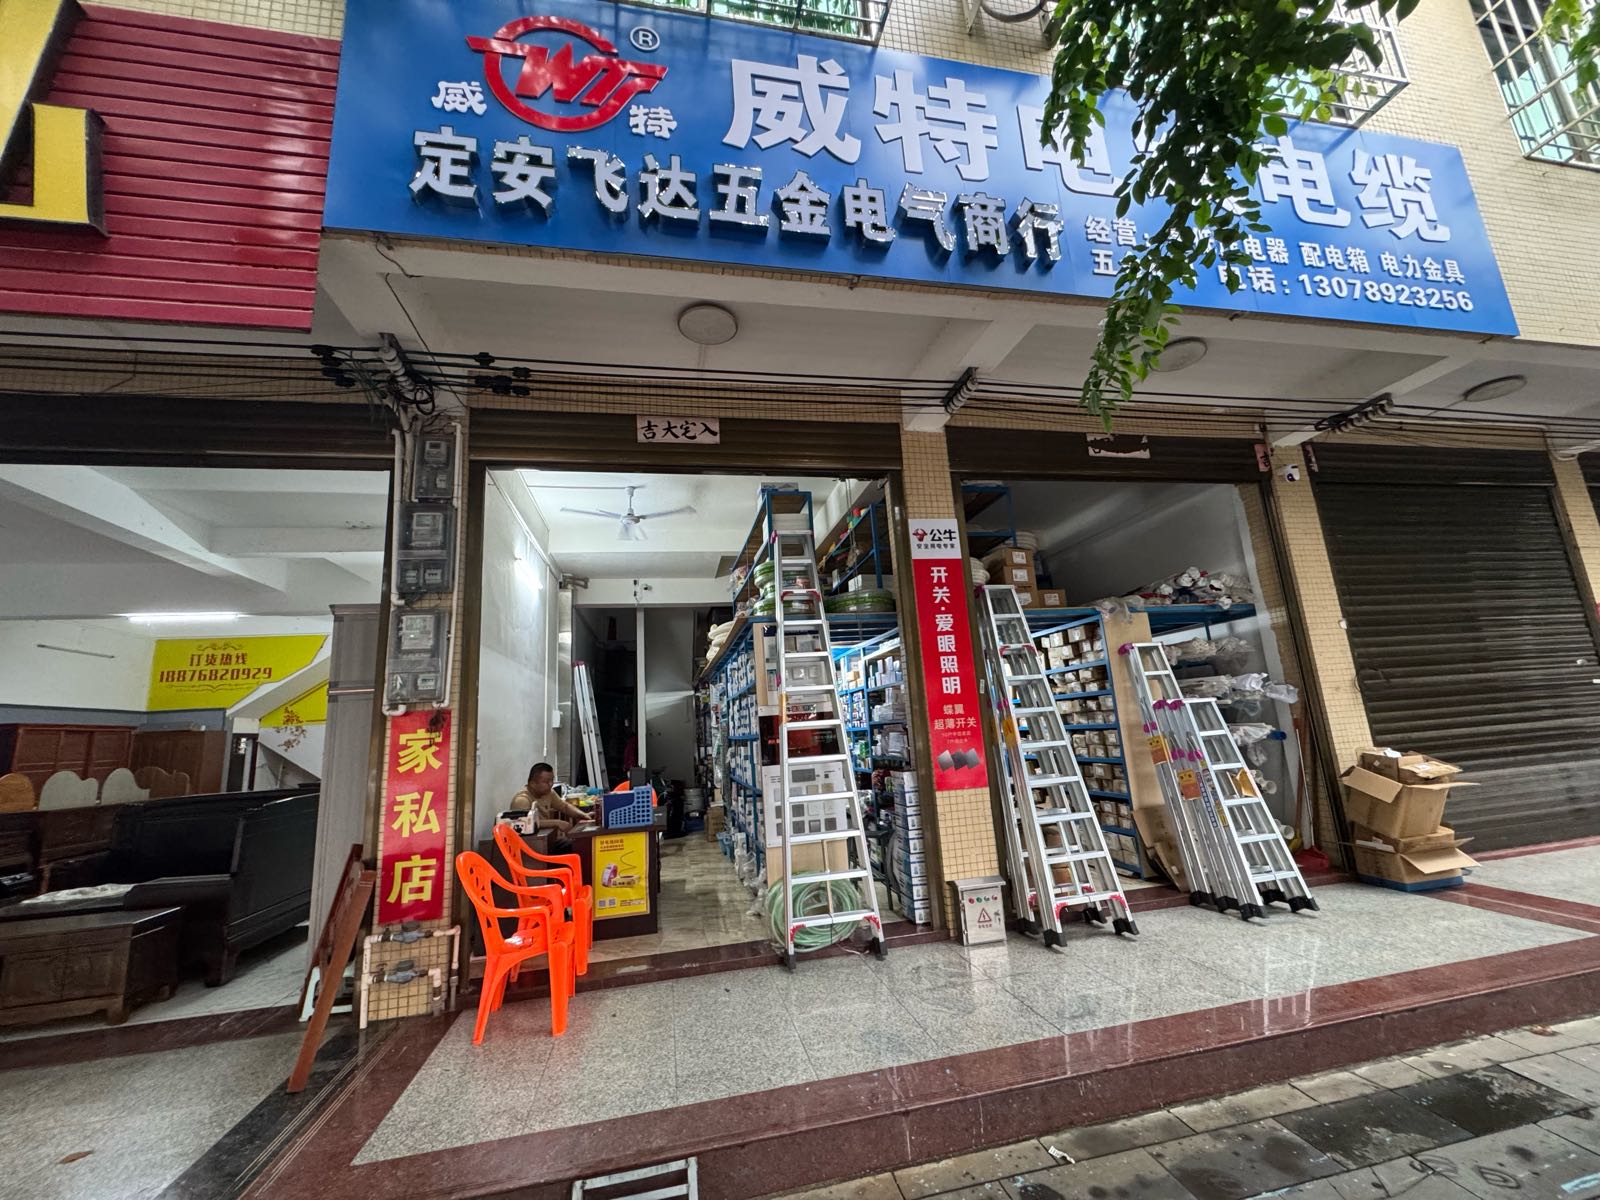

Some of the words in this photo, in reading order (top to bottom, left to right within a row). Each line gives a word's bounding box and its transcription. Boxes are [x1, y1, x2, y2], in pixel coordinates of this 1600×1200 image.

[431, 81, 487, 116] 威
[629, 104, 677, 139] 特
[722, 54, 1451, 242] 威特电电缆
[408, 126, 1065, 262] 定安飞达五金电气商行
[1298, 242, 1371, 275] 配电箱
[1379, 251, 1466, 285] 电力金具
[929, 527, 957, 542] 公牛
[159, 667, 273, 683] 18876820929
[189, 652, 248, 667] 订货热线
[387, 728, 443, 904] 家私店
